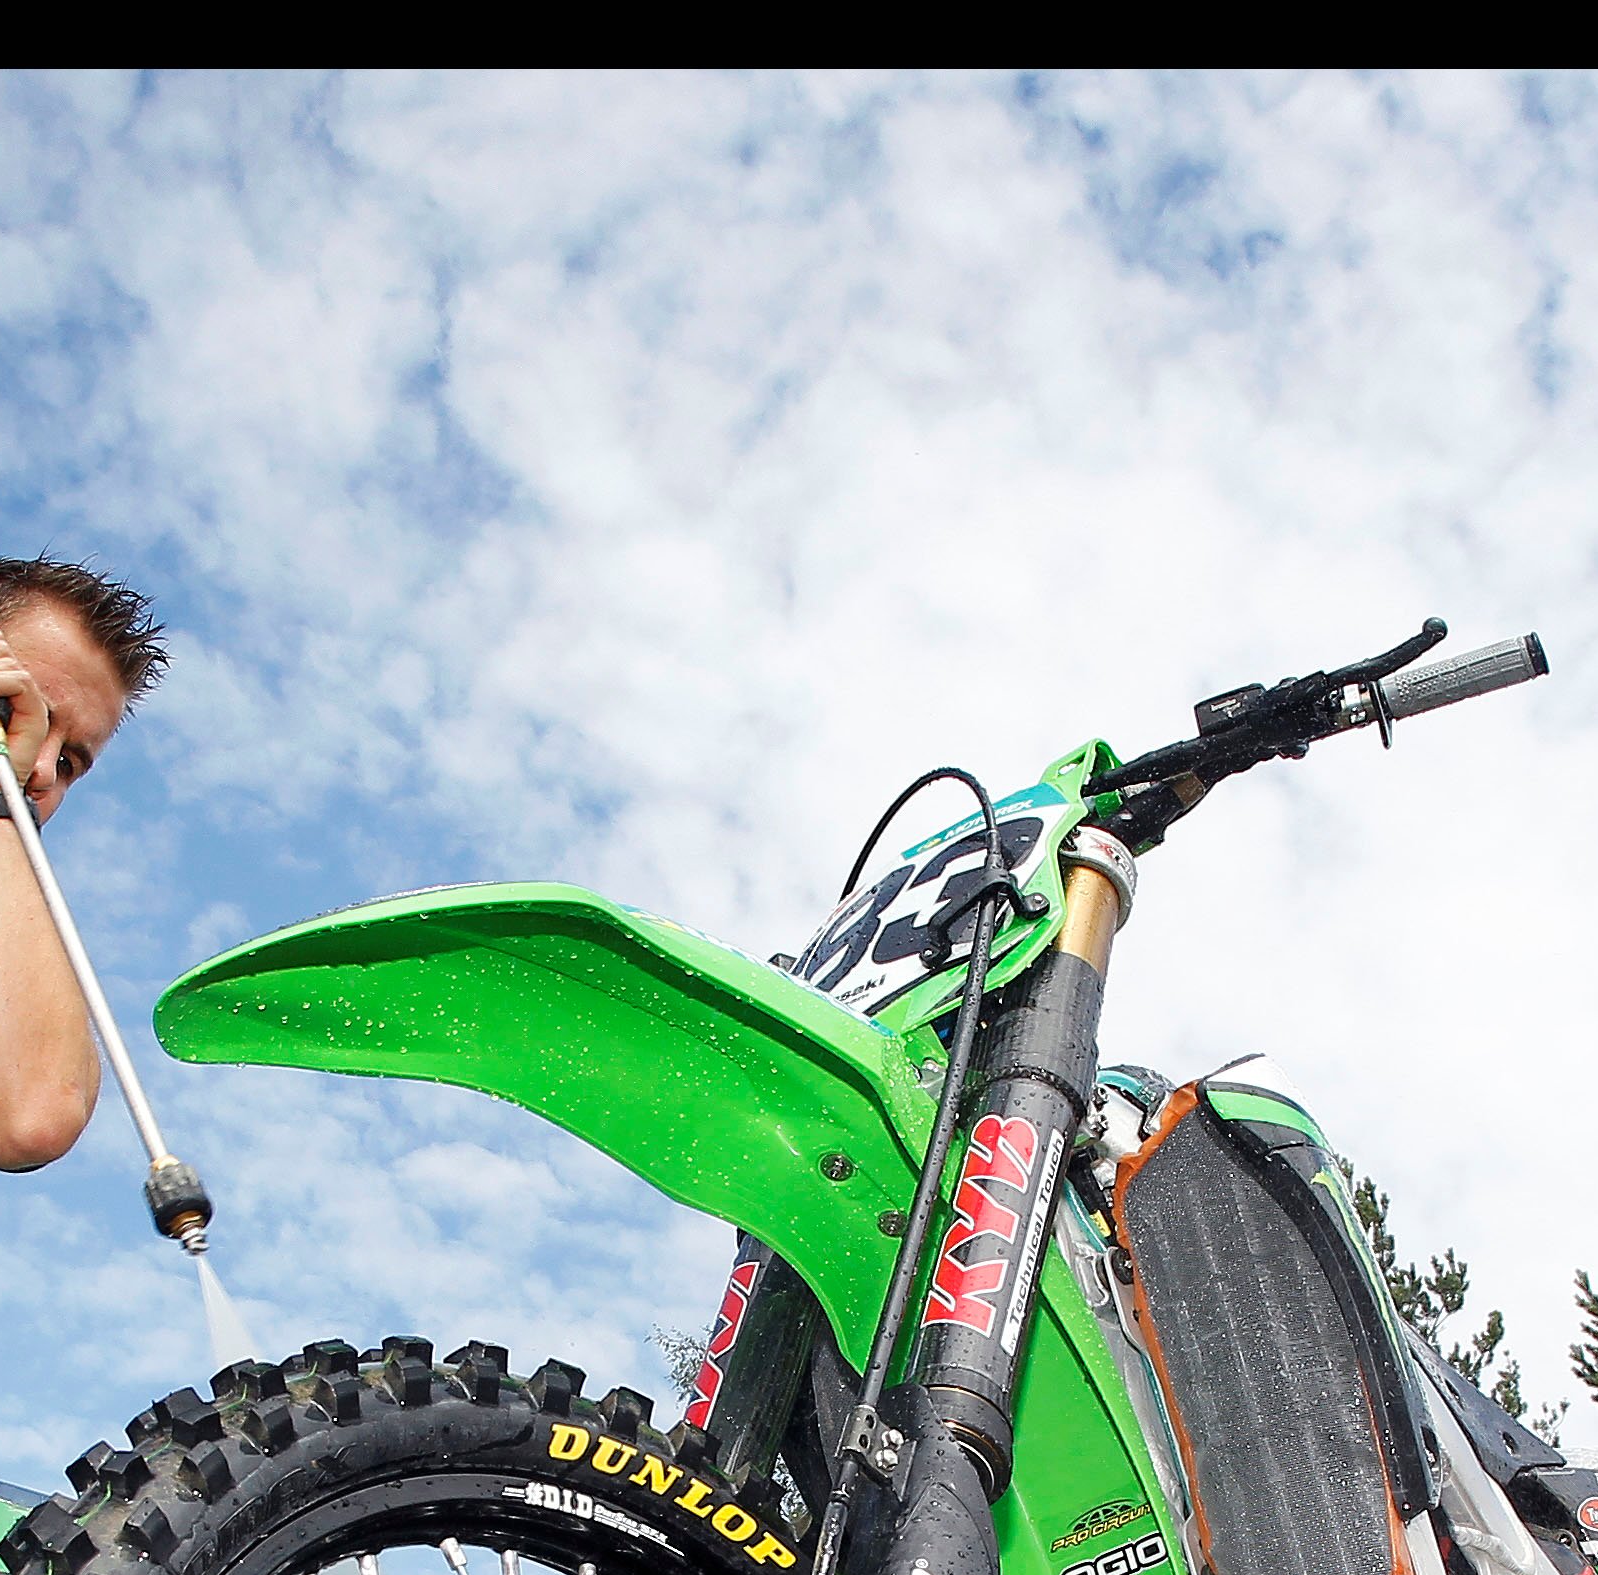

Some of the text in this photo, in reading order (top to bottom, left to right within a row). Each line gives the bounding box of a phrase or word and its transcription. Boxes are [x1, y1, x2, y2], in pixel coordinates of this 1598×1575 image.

[920, 1114, 1039, 1339] KYB
[1010, 1214, 1045, 1329] Technical
[1039, 1138, 1064, 1205] Touch
[548, 1422, 797, 1569] DUNLOP
[1052, 1529, 1091, 1552] PRO
